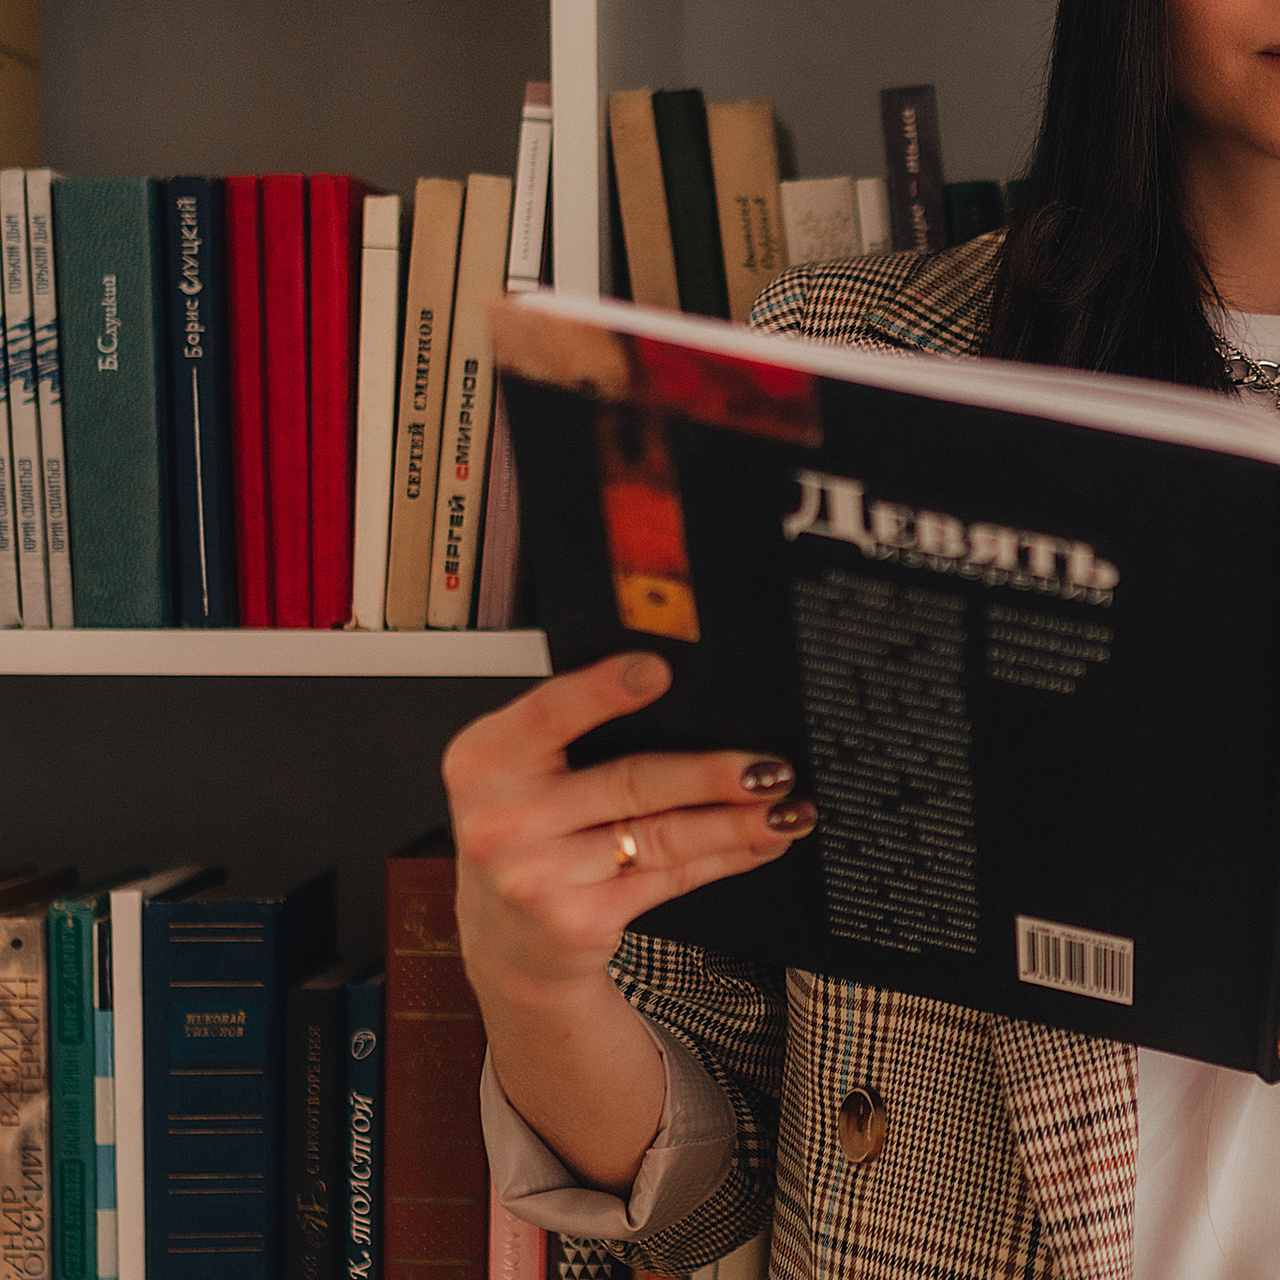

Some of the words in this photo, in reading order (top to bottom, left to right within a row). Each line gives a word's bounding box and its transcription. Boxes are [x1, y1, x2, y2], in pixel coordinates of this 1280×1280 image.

[5, 213, 21, 243] ДЫМ
[32, 213, 48, 244] ДЫМ
[182, 299, 206, 359] Борис
[412, 308, 434, 412] СМИРНОВ
[453, 357, 481, 482] СМИРНОВ
[18, 458, 35, 519] СИЛАНТЬЕВ
[47, 458, 63, 519] СИЛАНТЬЕВ
[405, 421, 426, 500] СЕРГЕЙ
[444, 494, 468, 592] СЕРГЕЙ
[17, 977, 41, 1096] ТЕРКИН
[305, 1023, 322, 1176] СТИХОТВОРЕНИЯ
[348, 1091, 375, 1246] ТОЛСТОЙ
[348, 1250, 373, 1280] К.
